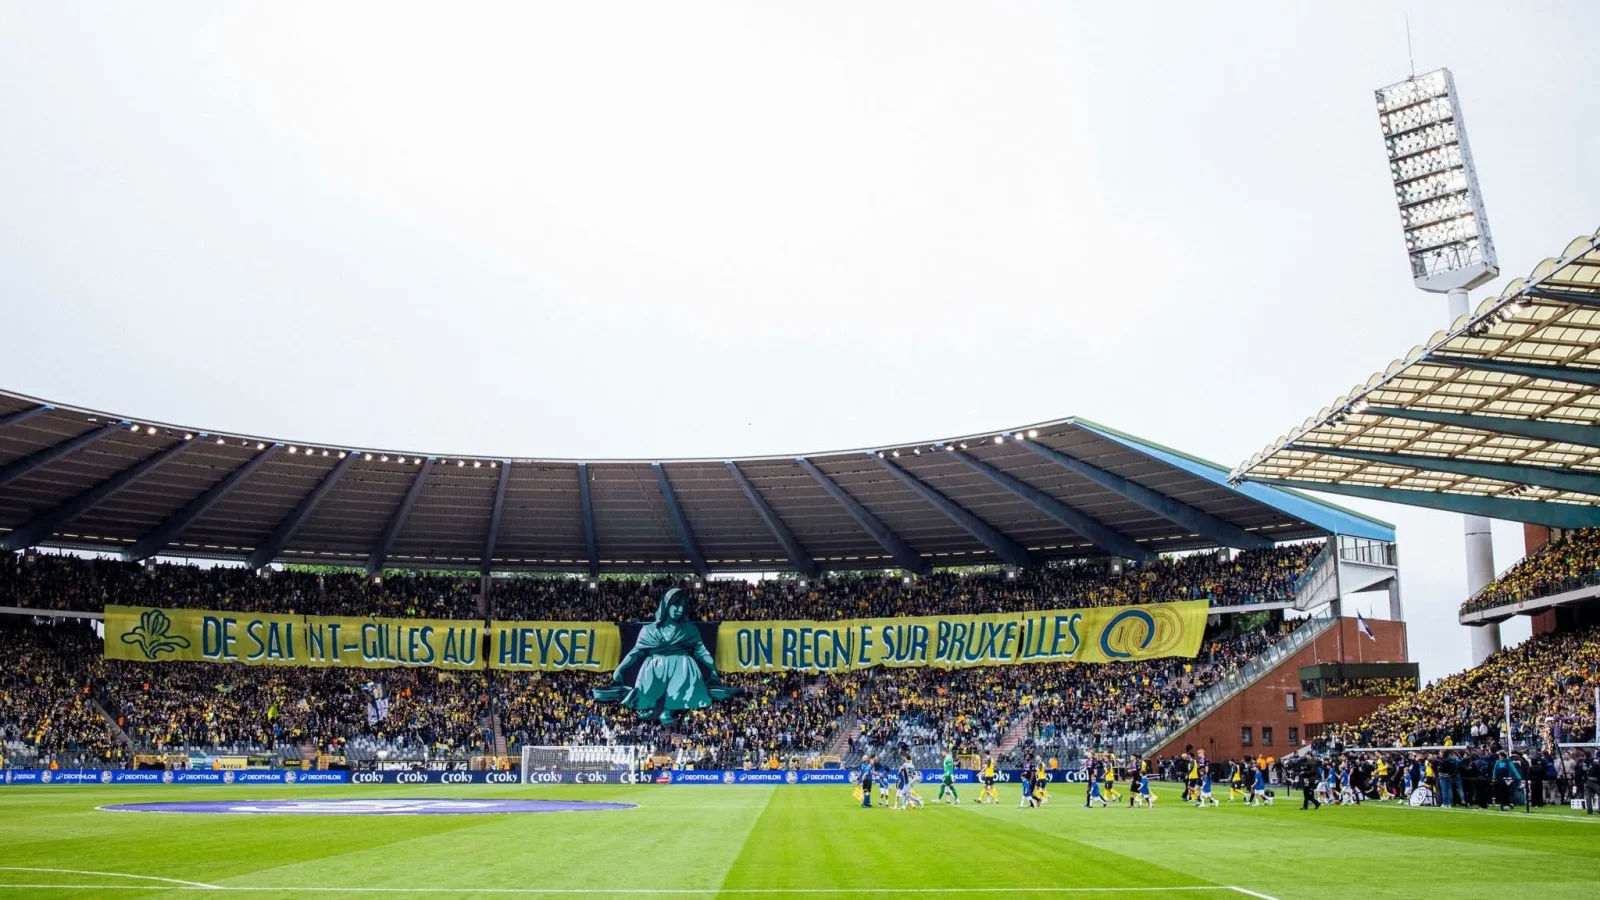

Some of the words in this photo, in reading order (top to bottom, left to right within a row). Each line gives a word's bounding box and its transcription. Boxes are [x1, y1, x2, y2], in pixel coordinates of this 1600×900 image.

[202, 616, 238, 660] DE
[443, 627, 477, 666] AU
[498, 628, 601, 667] HEYSEL
[737, 627, 774, 669] ON
[782, 625, 873, 671] REGNE
[881, 624, 929, 664] SUR
[934, 613, 1082, 664] BRUXELLES
[352, 770, 383, 783] Croky
[396, 770, 428, 783] Croky
[441, 770, 473, 783] Croky
[485, 770, 517, 783] Croky
